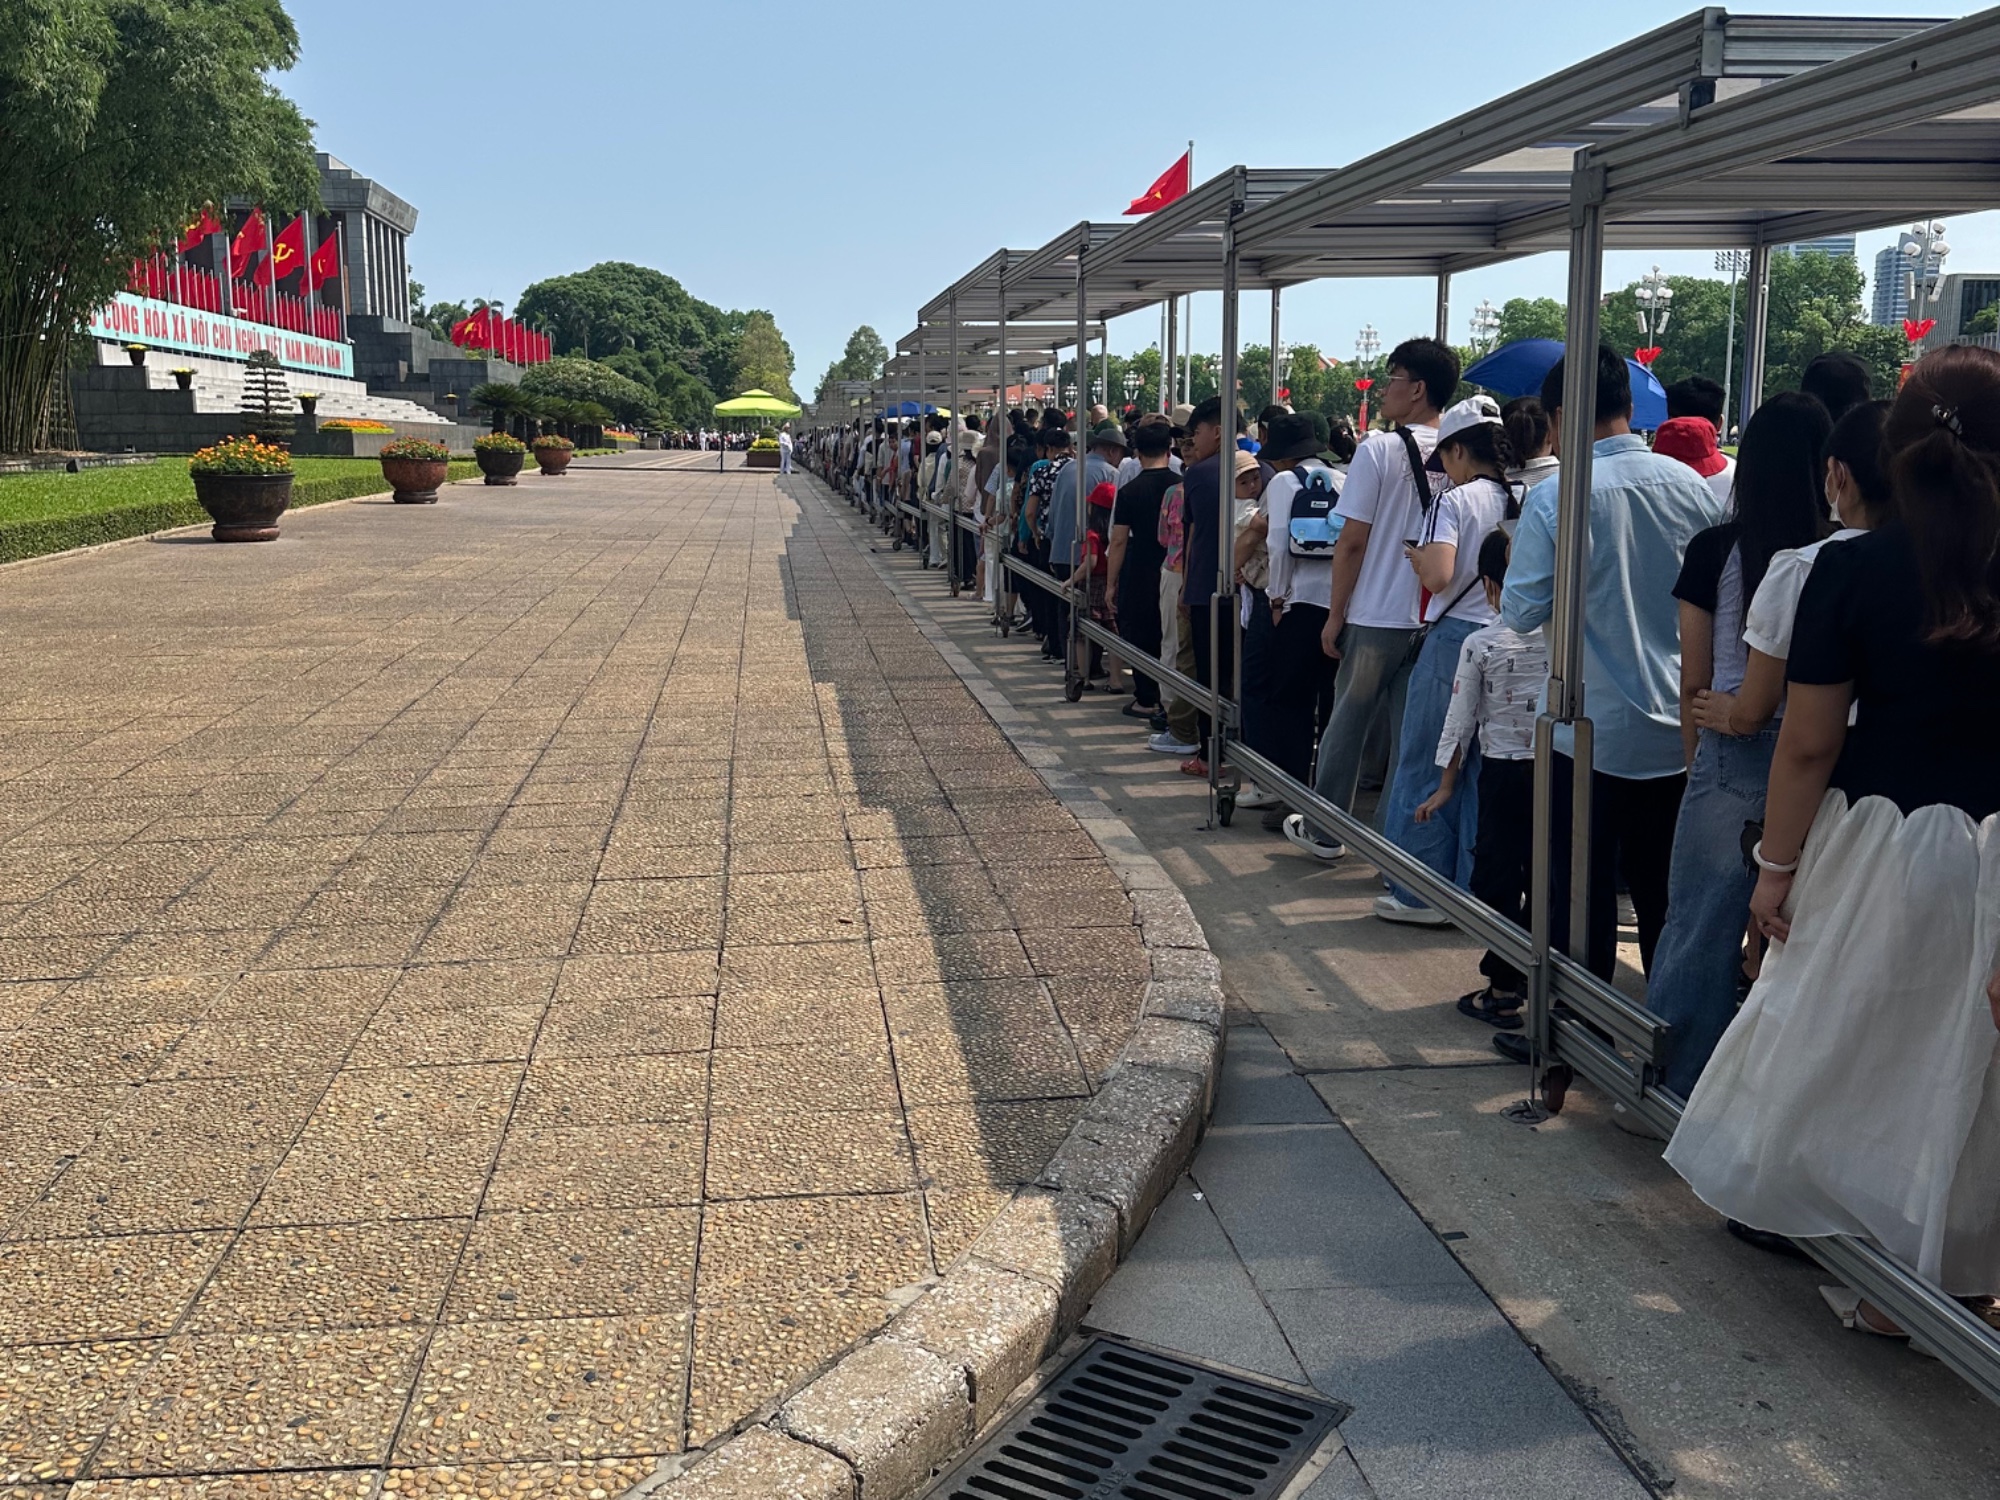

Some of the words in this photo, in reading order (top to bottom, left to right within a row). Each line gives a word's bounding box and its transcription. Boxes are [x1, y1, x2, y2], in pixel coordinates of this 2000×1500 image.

[144, 303, 168, 340] HÒA
[172, 311, 188, 343] XÃ
[191, 314, 210, 351] HỘI
[213, 318, 232, 350] CHỦ
[285, 338, 302, 362] NAM
